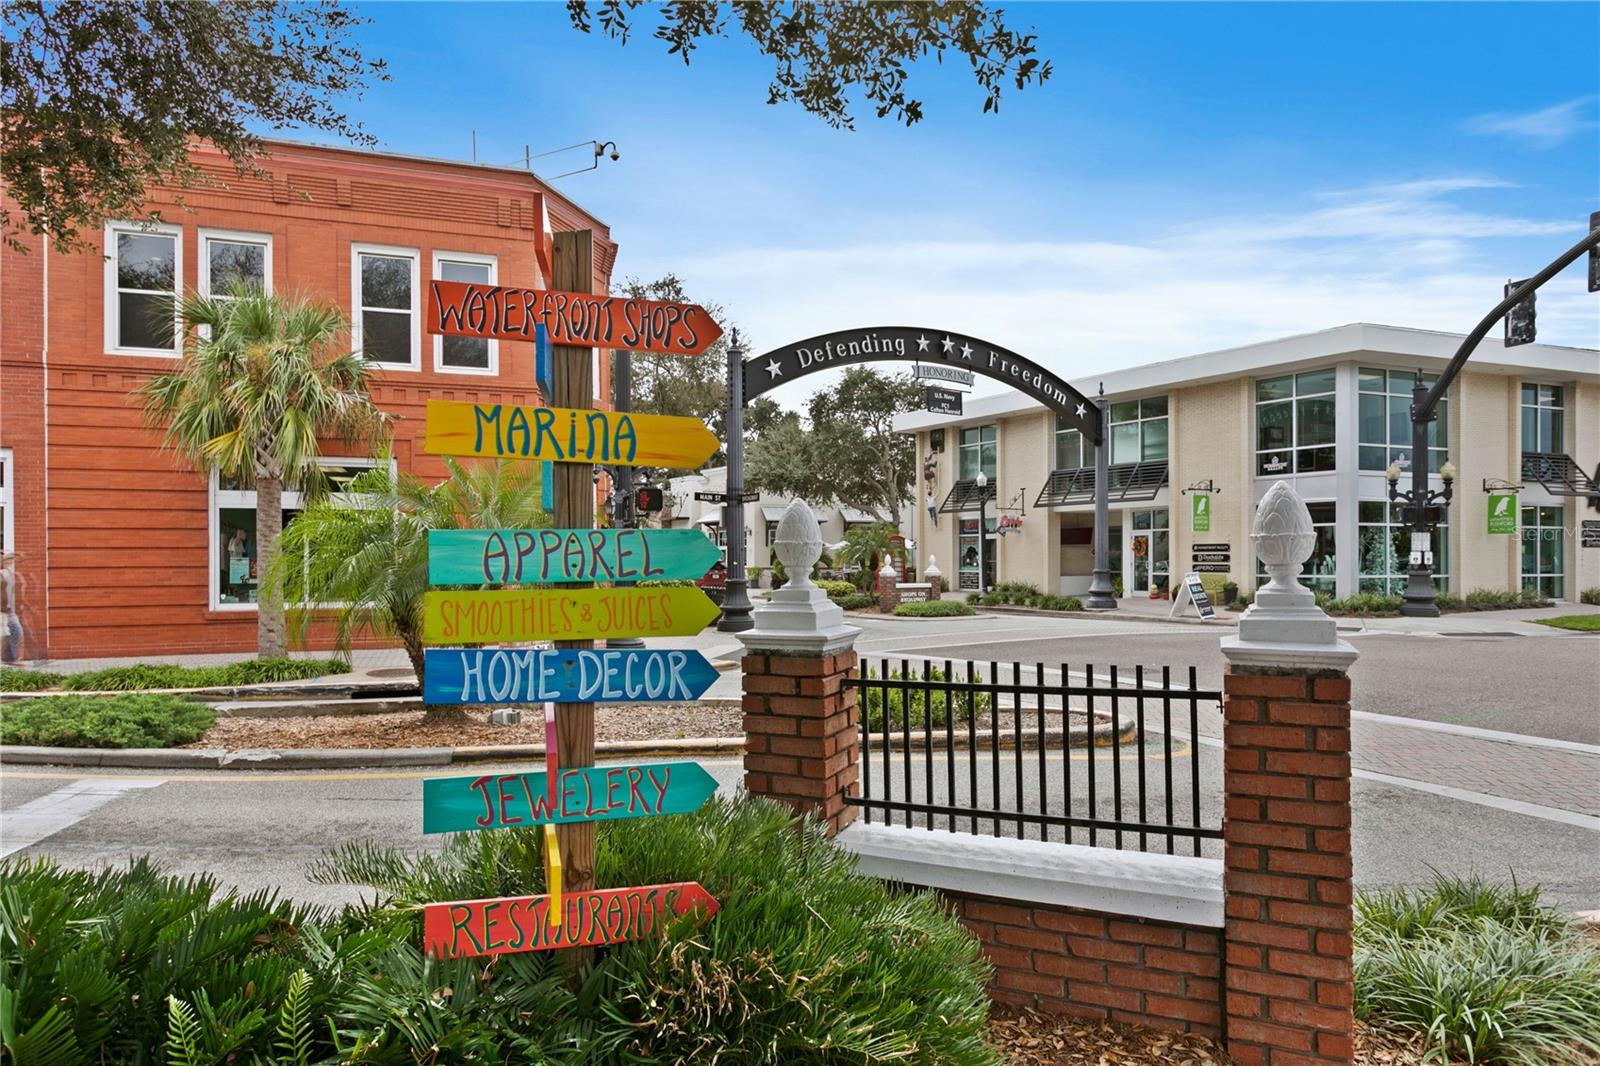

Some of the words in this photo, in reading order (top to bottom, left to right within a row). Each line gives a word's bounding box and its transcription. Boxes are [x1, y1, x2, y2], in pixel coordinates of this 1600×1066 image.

[622, 300, 697, 348] SHOPS
[796, 333, 905, 369] Defending
[988, 350, 1067, 405] Freedom
[923, 366, 970, 381] HONORING
[482, 530, 664, 582] APPAREL
[579, 603, 593, 622] &
[461, 650, 561, 701] HOME
[578, 650, 693, 700] DECOR
[469, 767, 670, 827] JEWELERY
